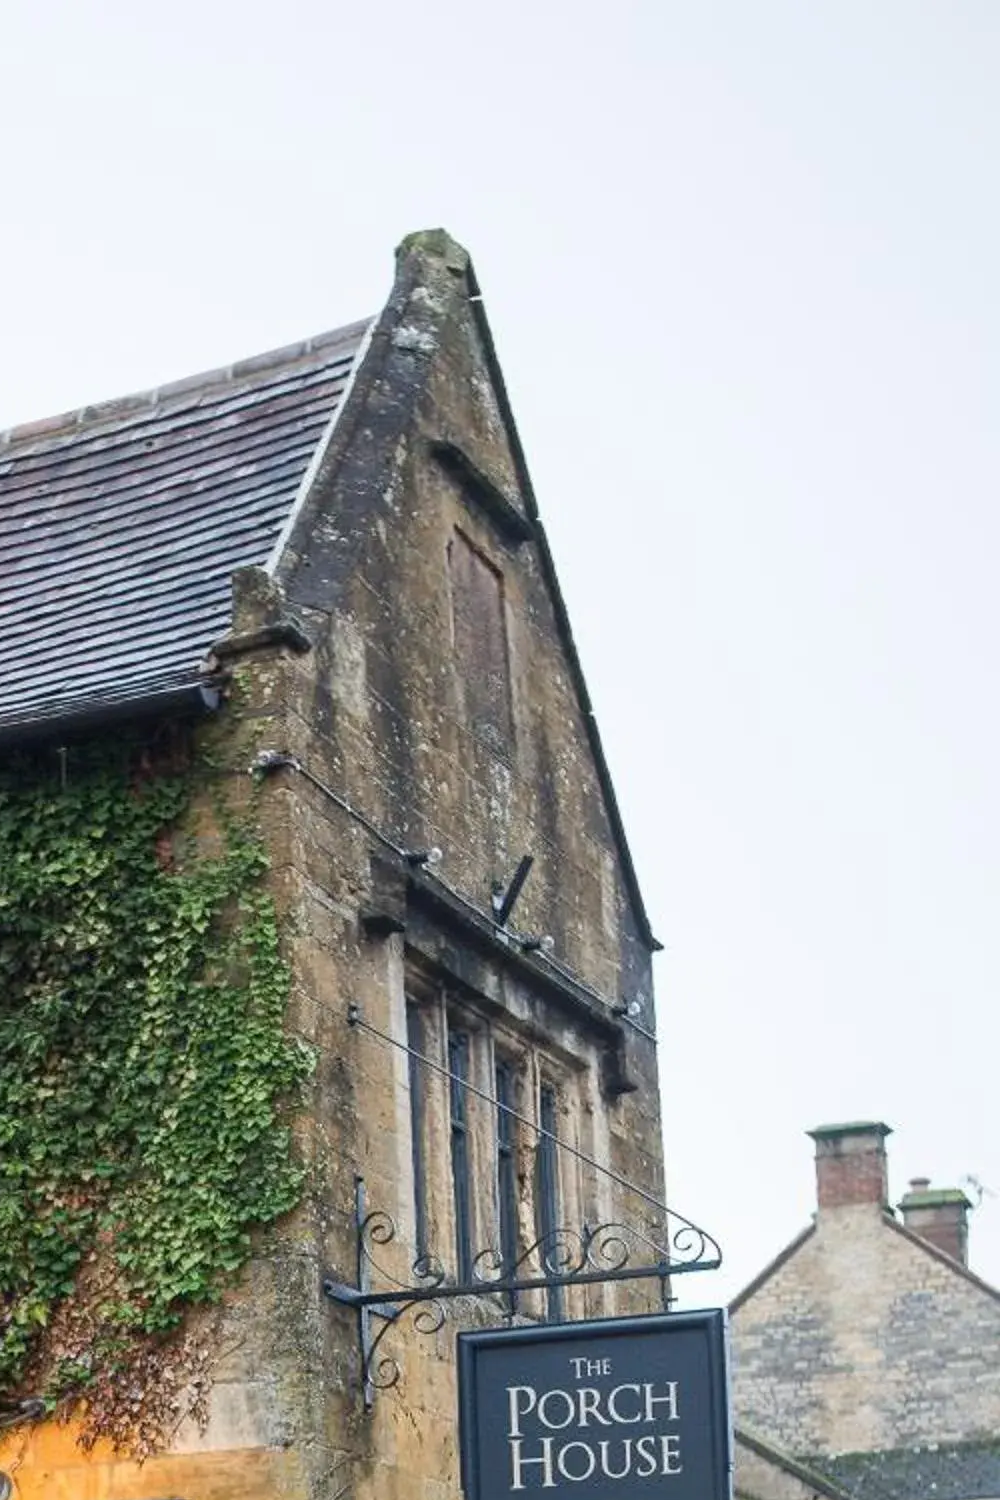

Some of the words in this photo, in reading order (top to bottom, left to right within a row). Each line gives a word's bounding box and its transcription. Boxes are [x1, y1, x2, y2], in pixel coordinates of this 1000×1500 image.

[569, 1357, 612, 1379] THE
[506, 1381, 681, 1438] PORCH
[508, 1435, 683, 1490] HOUSE
